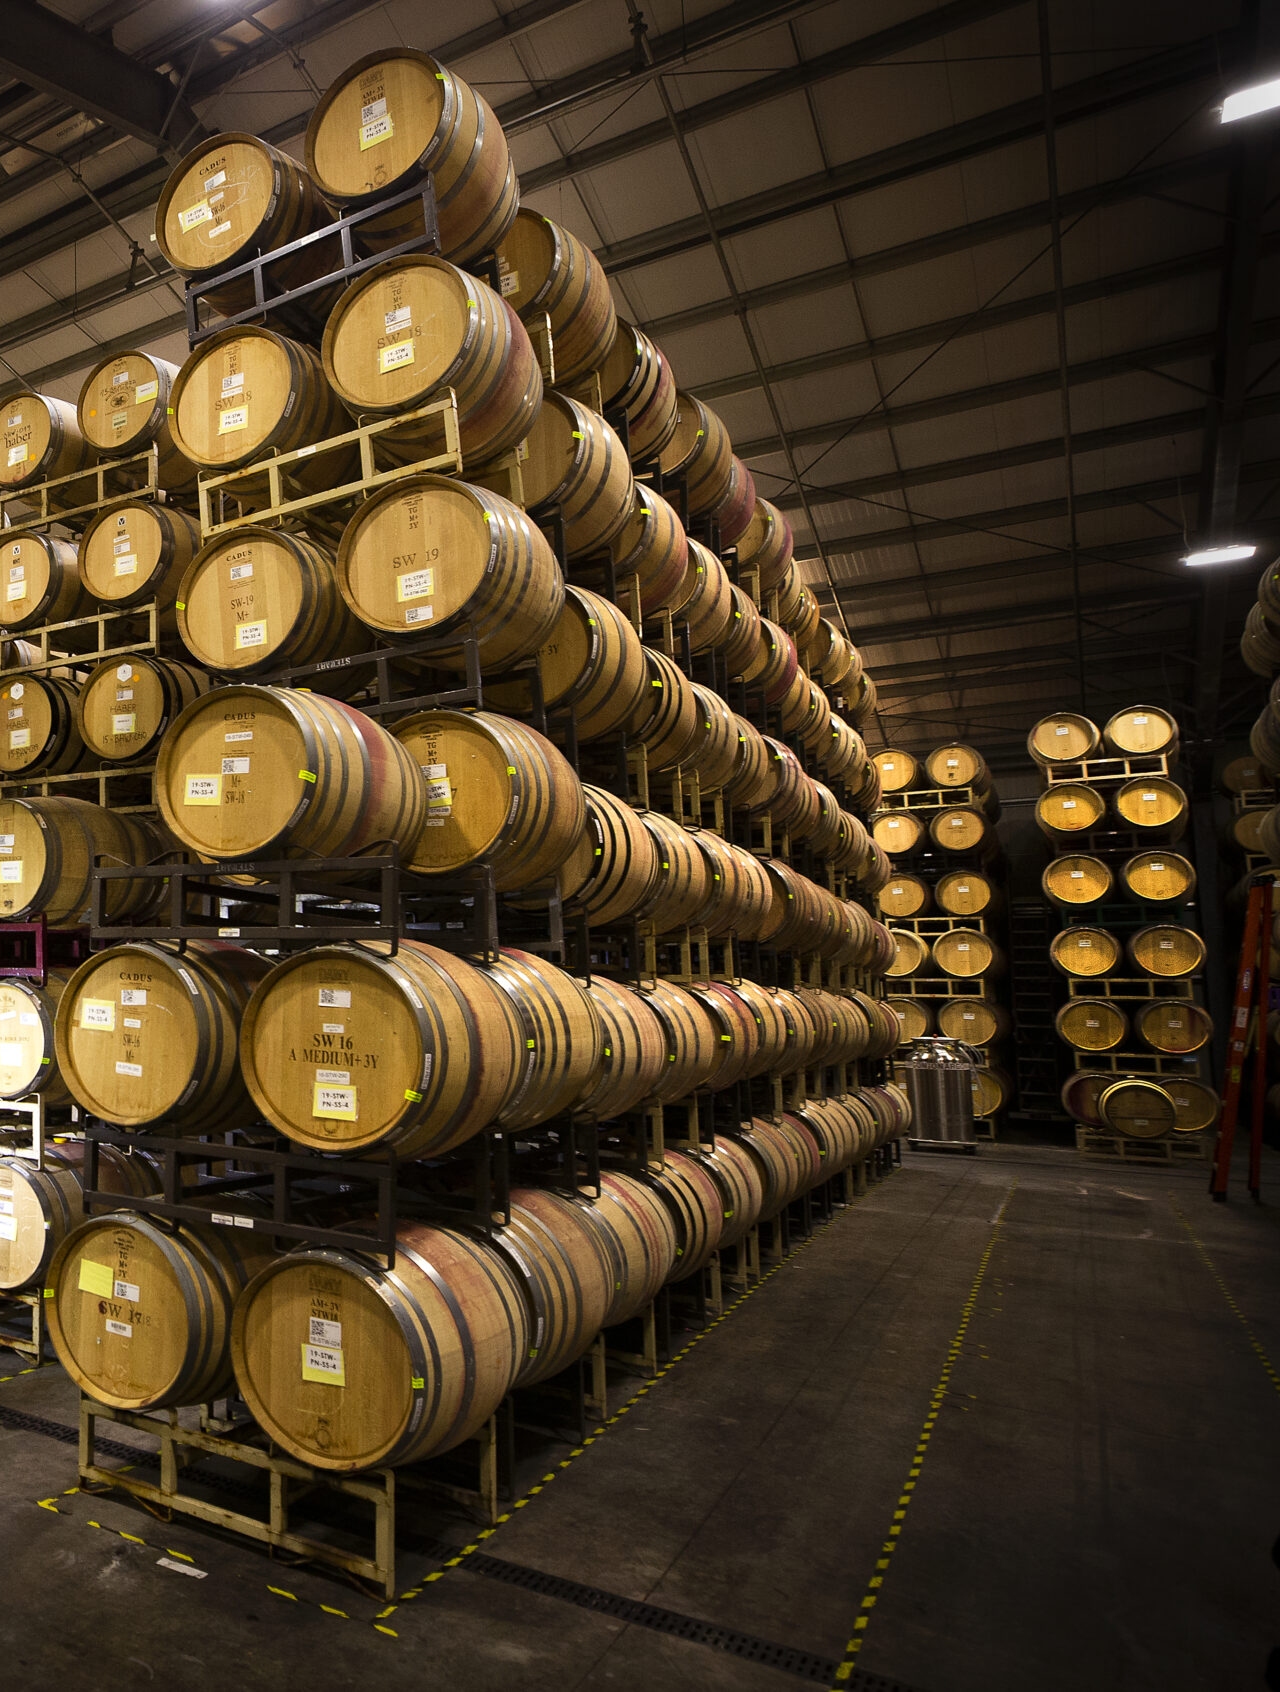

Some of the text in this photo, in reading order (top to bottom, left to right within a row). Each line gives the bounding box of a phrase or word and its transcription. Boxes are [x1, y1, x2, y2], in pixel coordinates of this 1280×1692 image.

[199, 157, 227, 175] CADUS
[377, 332, 401, 350] SW
[409, 325, 422, 339] 18
[214, 397, 234, 411] SW
[241, 390, 252, 403] 18
[5, 431, 32, 448] haber
[226, 550, 253, 562] CADUS
[392, 547, 439, 569] SW 19
[231, 595, 254, 610] SW-19
[236, 611, 249, 622] M+
[316, 656, 351, 671] STEWART
[109, 703, 137, 713] HABER
[223, 712, 256, 721] CADUS
[427, 749, 437, 757] M+
[427, 757, 438, 765] 3Y
[119, 972, 153, 982] CADUS
[312, 1033, 353, 1050] SW 16
[288, 1048, 297, 1061] A
[119, 1251, 128, 1260] TG
[118, 1269, 127, 1278] 3Y
[98, 1300, 122, 1318] SW
[310, 1358, 337, 1370] PN-SS-4
